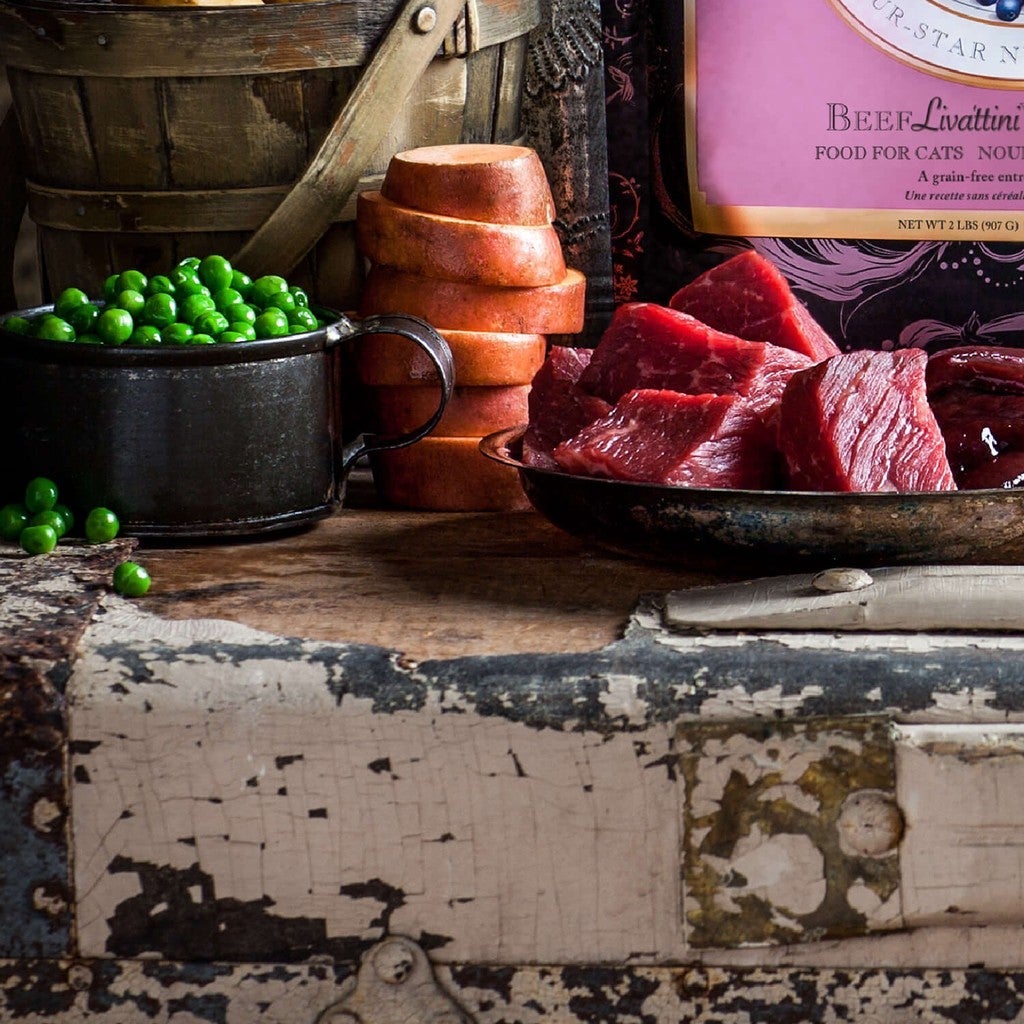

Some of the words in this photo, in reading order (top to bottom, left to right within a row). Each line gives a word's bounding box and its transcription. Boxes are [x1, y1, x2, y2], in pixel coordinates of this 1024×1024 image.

[815, 145, 867, 161] FOOD
[872, 145, 911, 161] FOR
[915, 145, 964, 161] CATS
[918, 170, 929, 182] A
[932, 170, 995, 186] grain-free
[905, 190, 927, 201] Une
[929, 190, 965, 201] recette
[967, 192, 990, 201] sans
[898, 219, 924, 230] NET
[926, 219, 947, 230] WT
[949, 220, 955, 231] 2
[957, 220, 979, 231] LBS
[981, 220, 1003, 232] (907
[1005, 220, 1020, 232] G)
